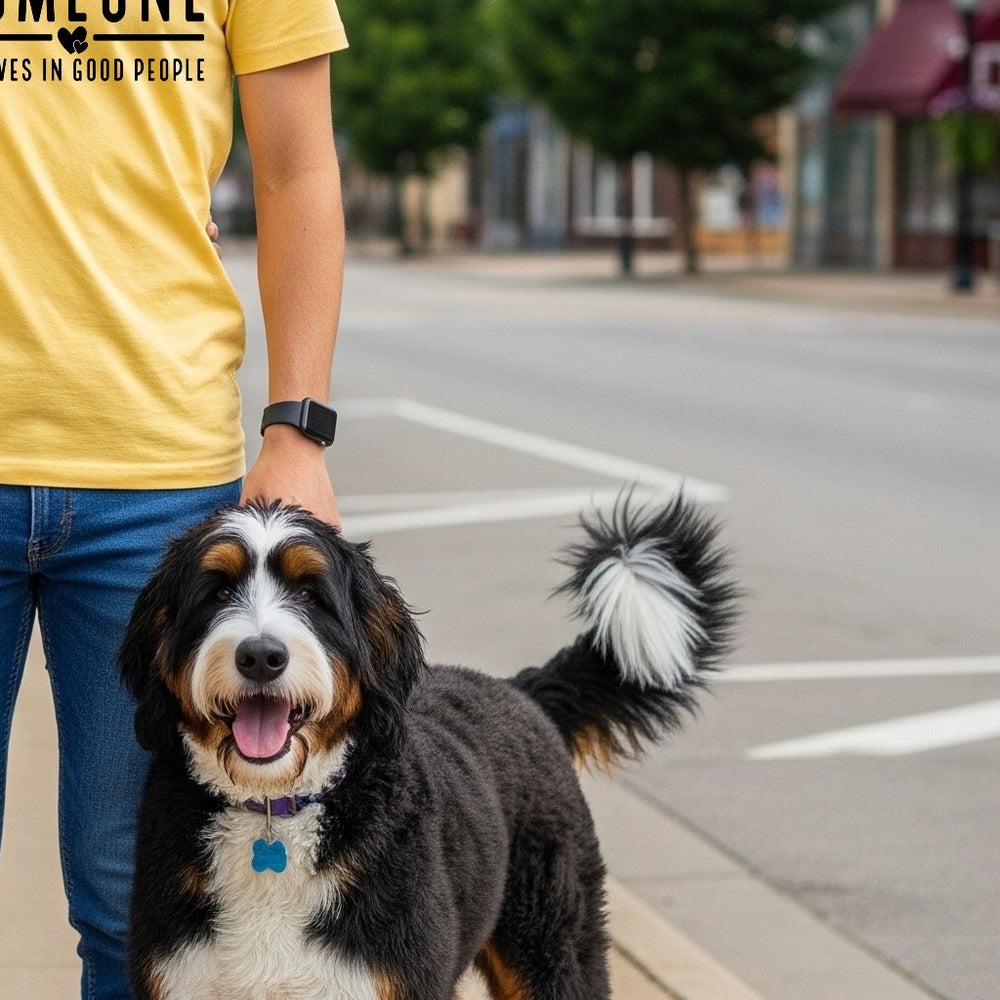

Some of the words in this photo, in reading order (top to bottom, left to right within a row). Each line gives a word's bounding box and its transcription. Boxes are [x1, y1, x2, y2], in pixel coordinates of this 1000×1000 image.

[42, 58, 62, 82] IN
[72, 58, 124, 82] GOOD
[134, 58, 205, 82] PEOPLE
